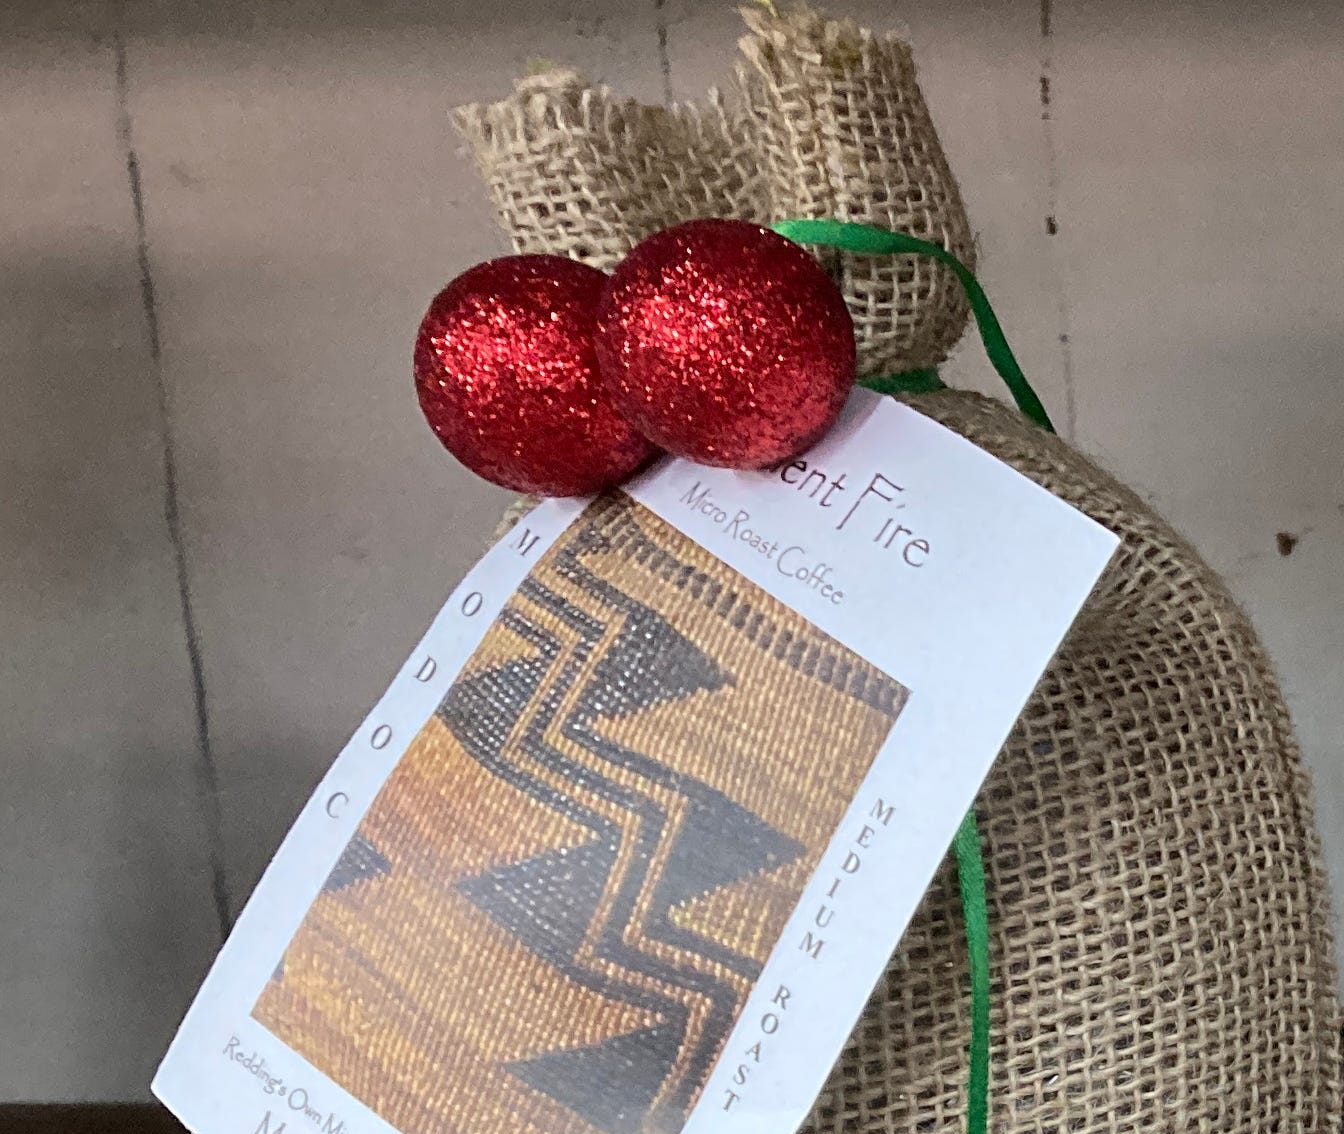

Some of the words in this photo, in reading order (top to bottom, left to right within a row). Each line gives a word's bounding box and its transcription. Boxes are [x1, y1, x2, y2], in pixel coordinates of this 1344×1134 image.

[678, 480, 727, 523] Micro
[722, 509, 778, 560] Roast
[776, 545, 844, 606] Coffee
[836, 472, 931, 568] Fire
[326, 528, 541, 819] MODOC
[798, 797, 897, 961] MEDIUM
[223, 1036, 287, 1096] Redding's
[287, 1087, 322, 1126] Own
[722, 984, 792, 1113] ROAST
